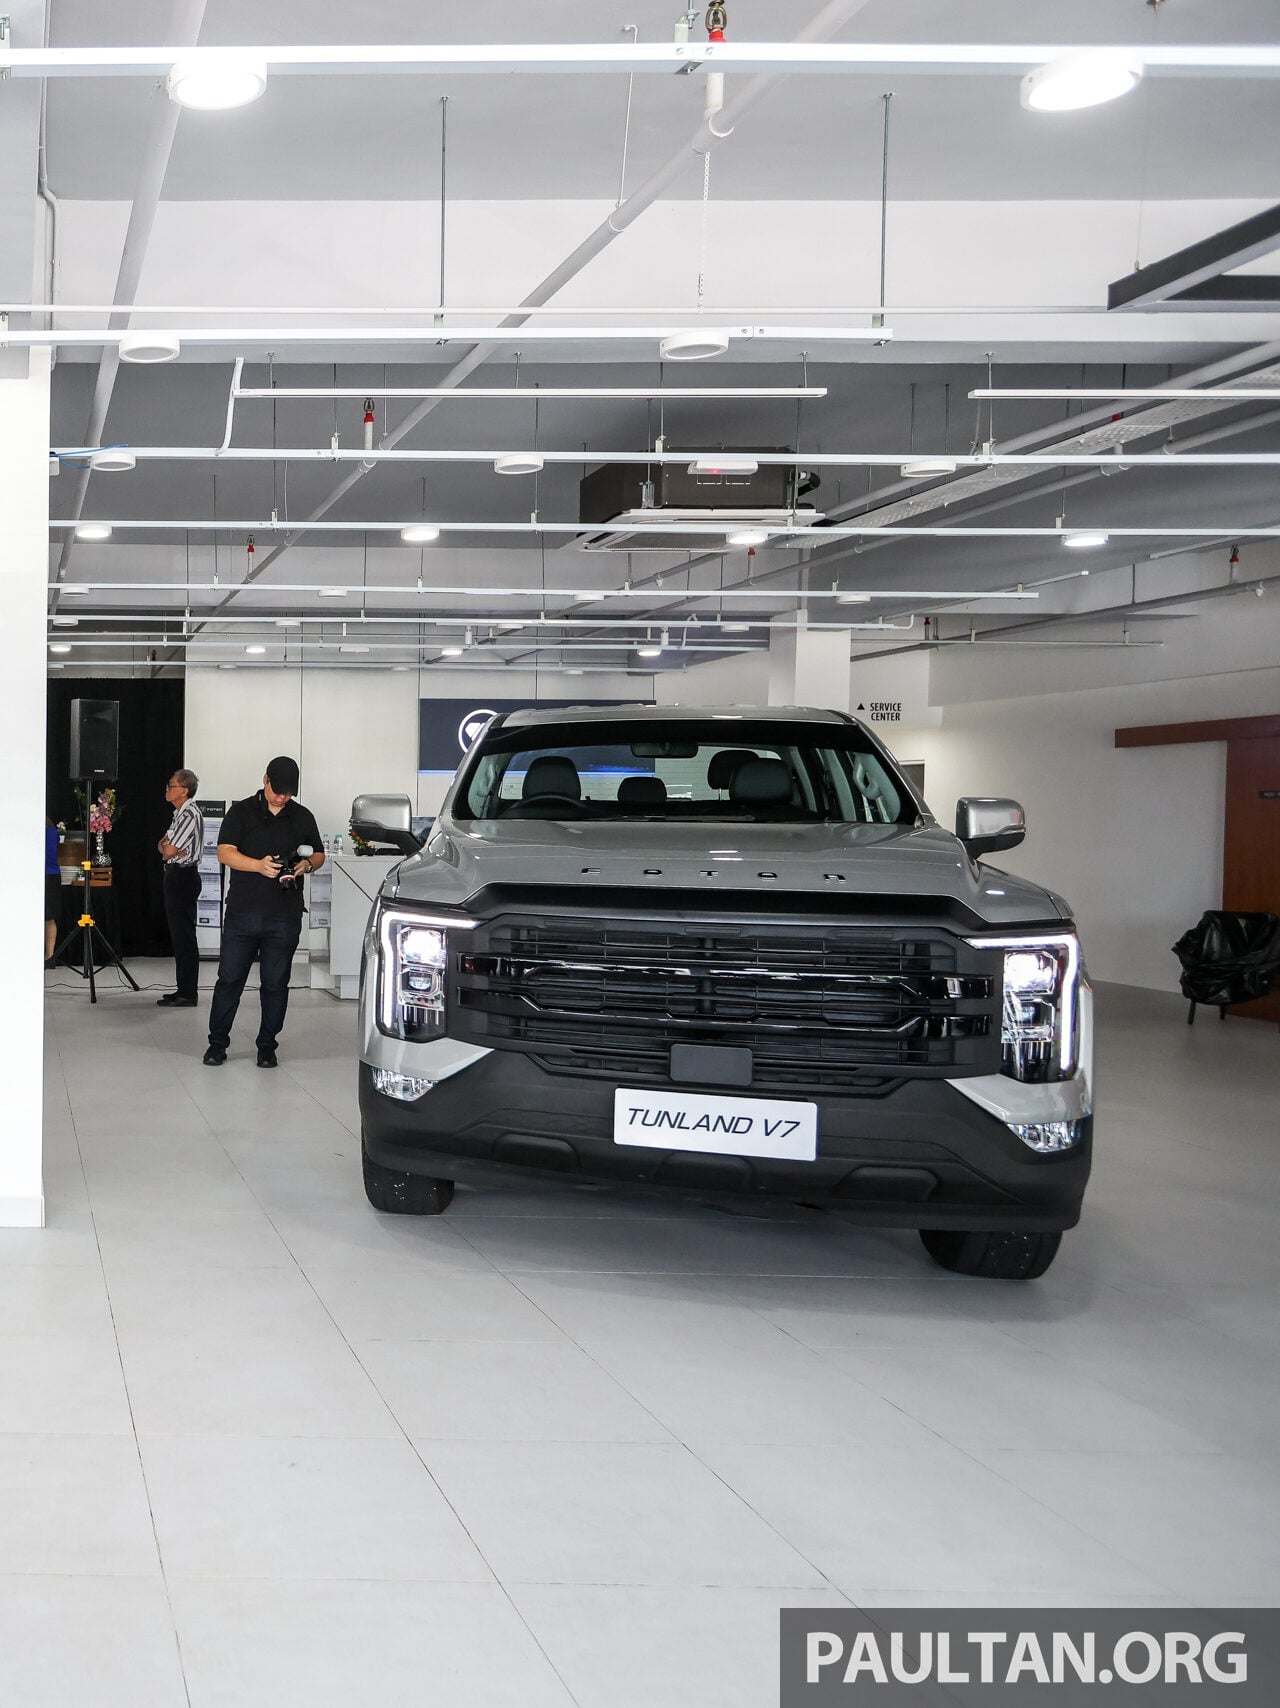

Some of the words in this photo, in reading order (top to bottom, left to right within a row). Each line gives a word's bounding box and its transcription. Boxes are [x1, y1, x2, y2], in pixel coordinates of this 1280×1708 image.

[870, 702, 902, 711] SERVICE
[871, 712, 901, 721] CENTER
[628, 1108, 753, 1134] TUNLAND
[764, 1118, 801, 1138] V7
